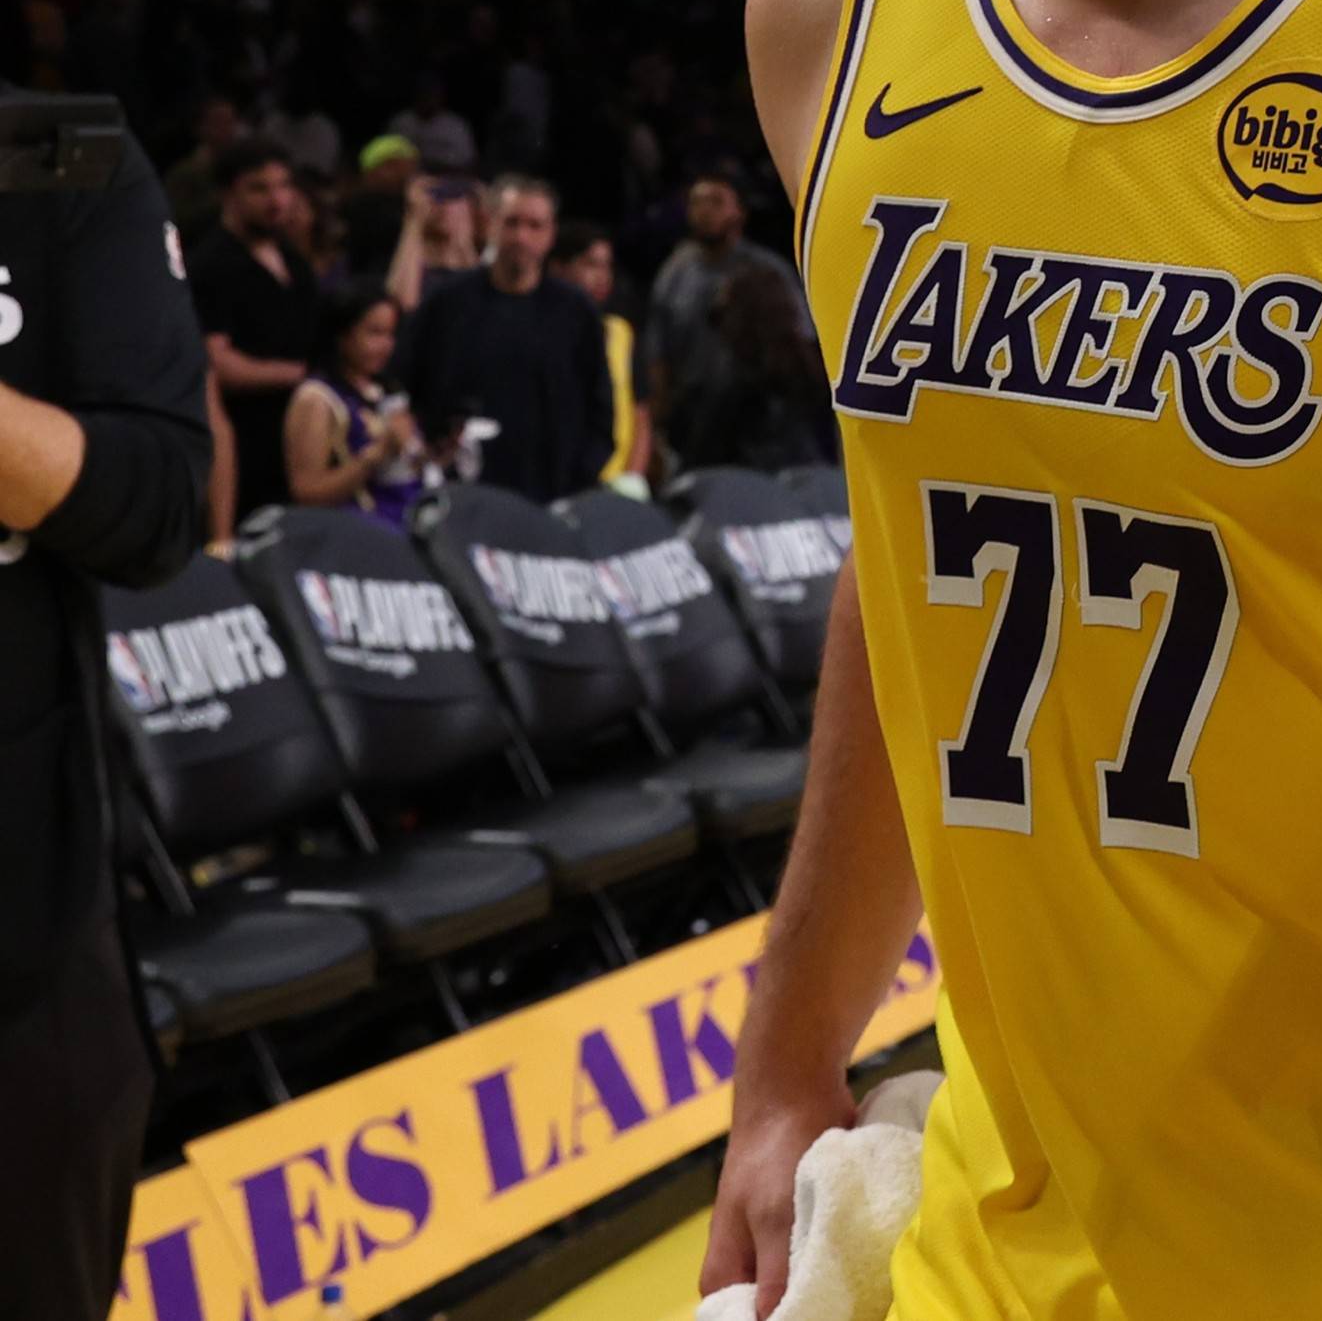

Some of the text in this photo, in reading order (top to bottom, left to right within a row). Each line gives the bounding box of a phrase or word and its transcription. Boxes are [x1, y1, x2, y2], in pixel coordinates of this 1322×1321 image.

[1251, 149, 1309, 175] 비비고
[918, 478, 1242, 860] 77
[113, 1107, 435, 1321] LES
